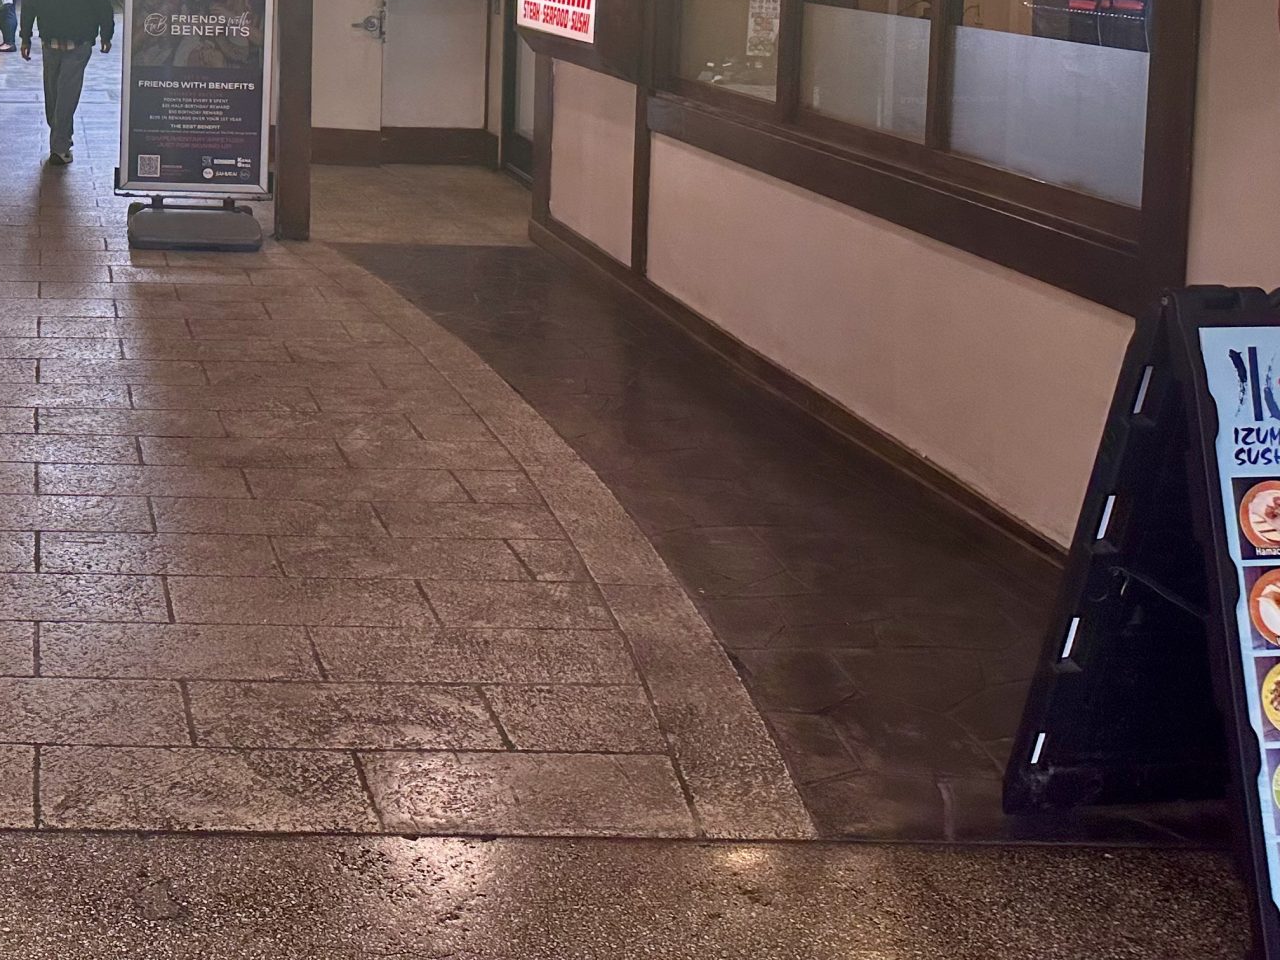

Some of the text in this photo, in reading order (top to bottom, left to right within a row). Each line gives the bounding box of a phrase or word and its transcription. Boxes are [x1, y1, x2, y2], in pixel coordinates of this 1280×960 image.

[171, 14, 226, 24] FRIENDS
[523, 0, 591, 34] STEAK SEAFOOD SUSHI
[170, 25, 251, 37] BENEFITS
[138, 80, 256, 91] FRIENDS WITH BENEFITS
